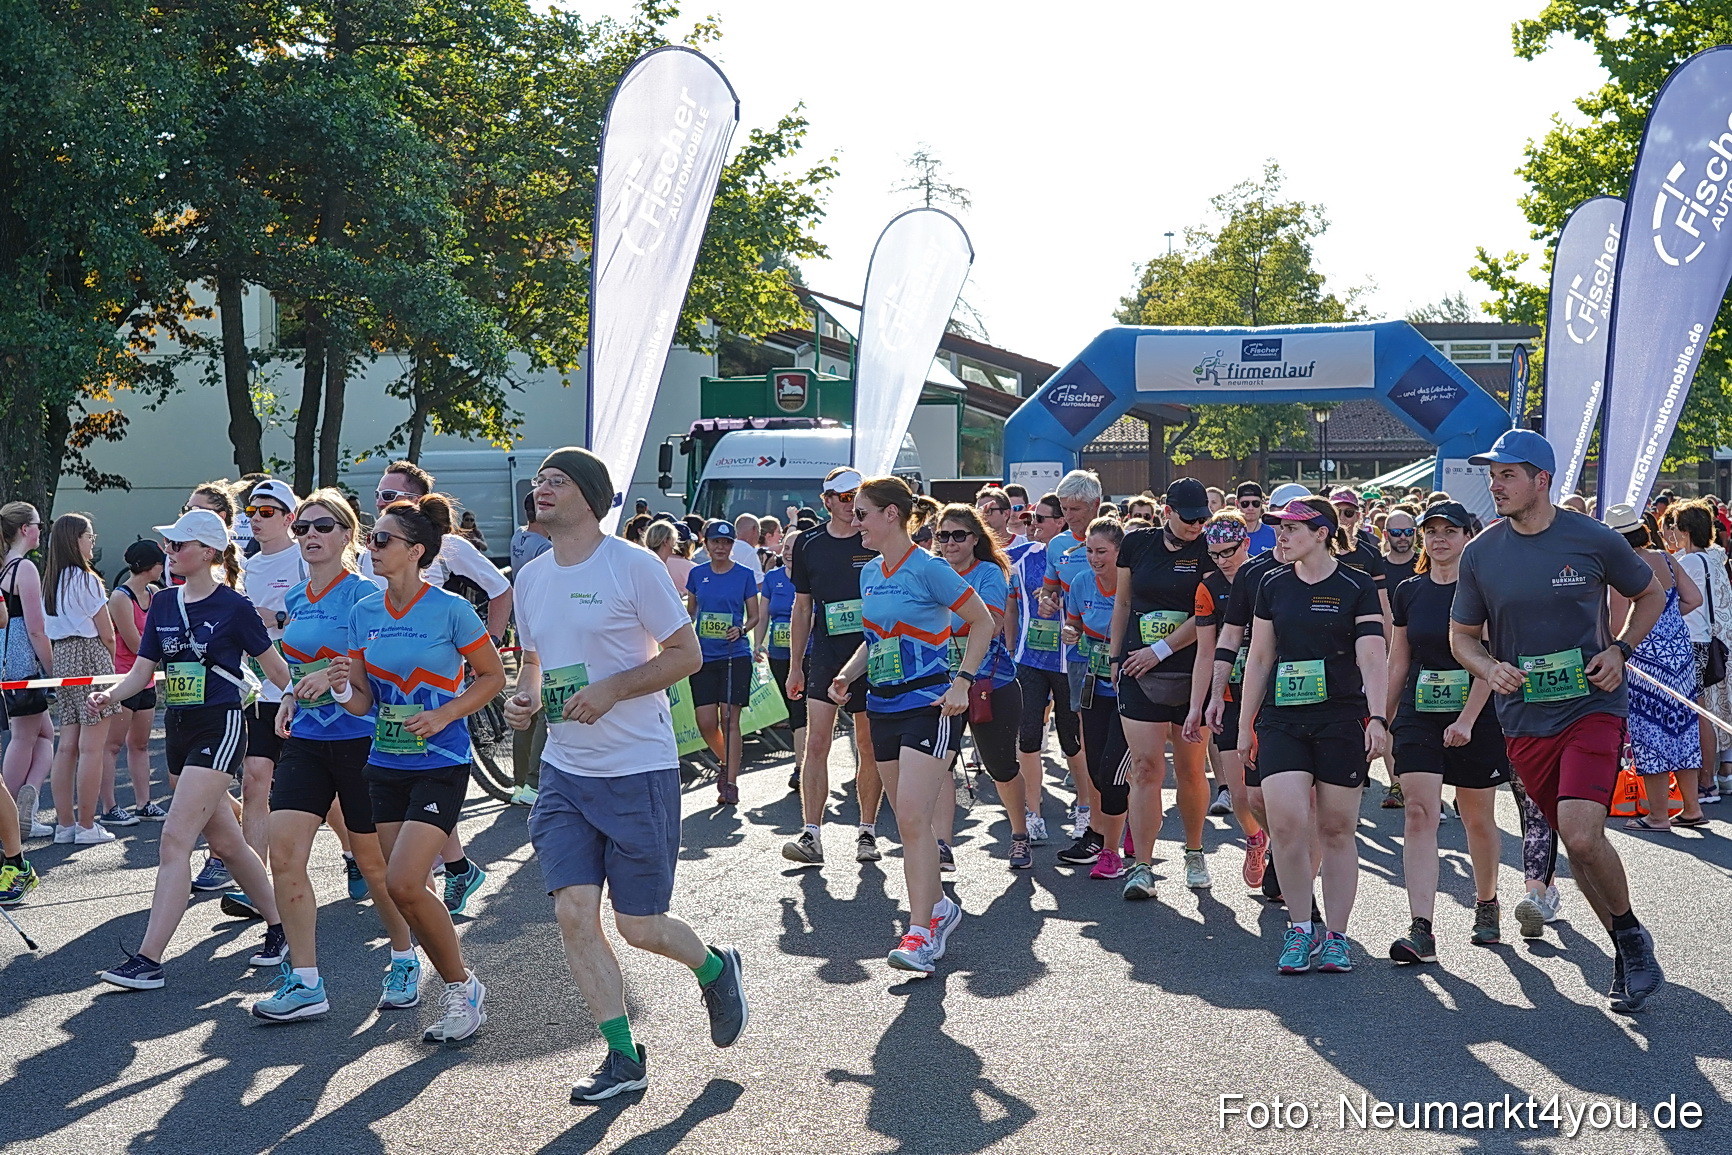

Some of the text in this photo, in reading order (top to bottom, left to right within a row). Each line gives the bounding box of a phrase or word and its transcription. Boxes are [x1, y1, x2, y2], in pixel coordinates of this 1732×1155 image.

[640, 86, 697, 229] Fischer
[668, 105, 710, 222] AUTOMOBILE
[1674, 111, 1732, 239] Fisch
[1578, 222, 1621, 325] Fischer
[1600, 271, 1615, 320] AUTO
[1250, 346, 1280, 354] Fischer
[1227, 360, 1316, 379] firmenlauf
[613, 308, 670, 487] w.fischer-automobile.de
[1057, 392, 1105, 403] Fischer
[1417, 386, 1430, 395] das
[1624, 322, 1704, 510] w.fischer-automobile.de
[1558, 380, 1602, 506] .fischer-automobile.de
[715, 456, 755, 467] abavent
[1551, 576, 1586, 584] BURKHARDT
[839, 611, 855, 623] 49
[704, 620, 727, 631] 1362
[1151, 621, 1176, 635] 580
[776, 631, 791, 640] 136
[1036, 629, 1043, 640] 7
[874, 654, 885, 671] 21
[893, 653, 901, 674] 2022
[167, 676, 196, 692] 1787
[1288, 676, 1306, 691] 57
[1524, 677, 1533, 693] RUN
[1534, 668, 1570, 687] 754
[1575, 667, 1585, 690] 2022
[1316, 676, 1325, 697] 2022
[1432, 684, 1452, 699] 54
[1552, 684, 1574, 693] Tobias
[385, 720, 403, 738] 27
[416, 735, 424, 747] 20
